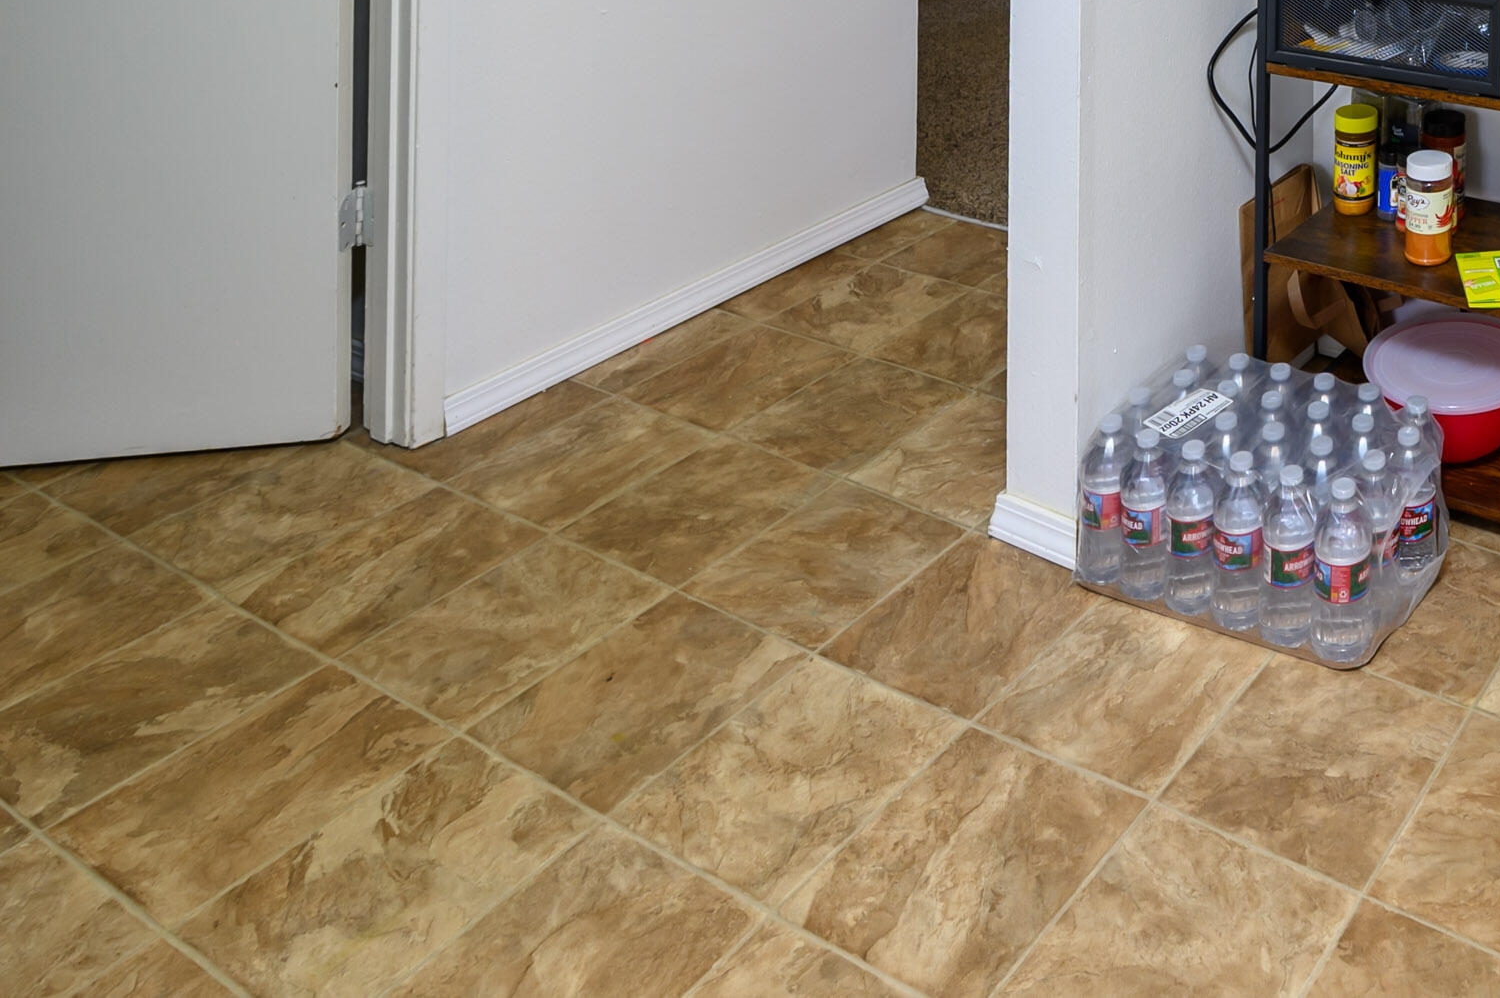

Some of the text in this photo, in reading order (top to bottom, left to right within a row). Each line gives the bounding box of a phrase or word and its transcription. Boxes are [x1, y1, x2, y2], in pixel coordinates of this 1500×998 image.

[1341, 168, 1355, 177] SALT
[1203, 393, 1218, 404] AH
[1180, 401, 1207, 419] 24PK
[1182, 528, 1213, 542] ARROW
[1284, 554, 1314, 571] ARROW
